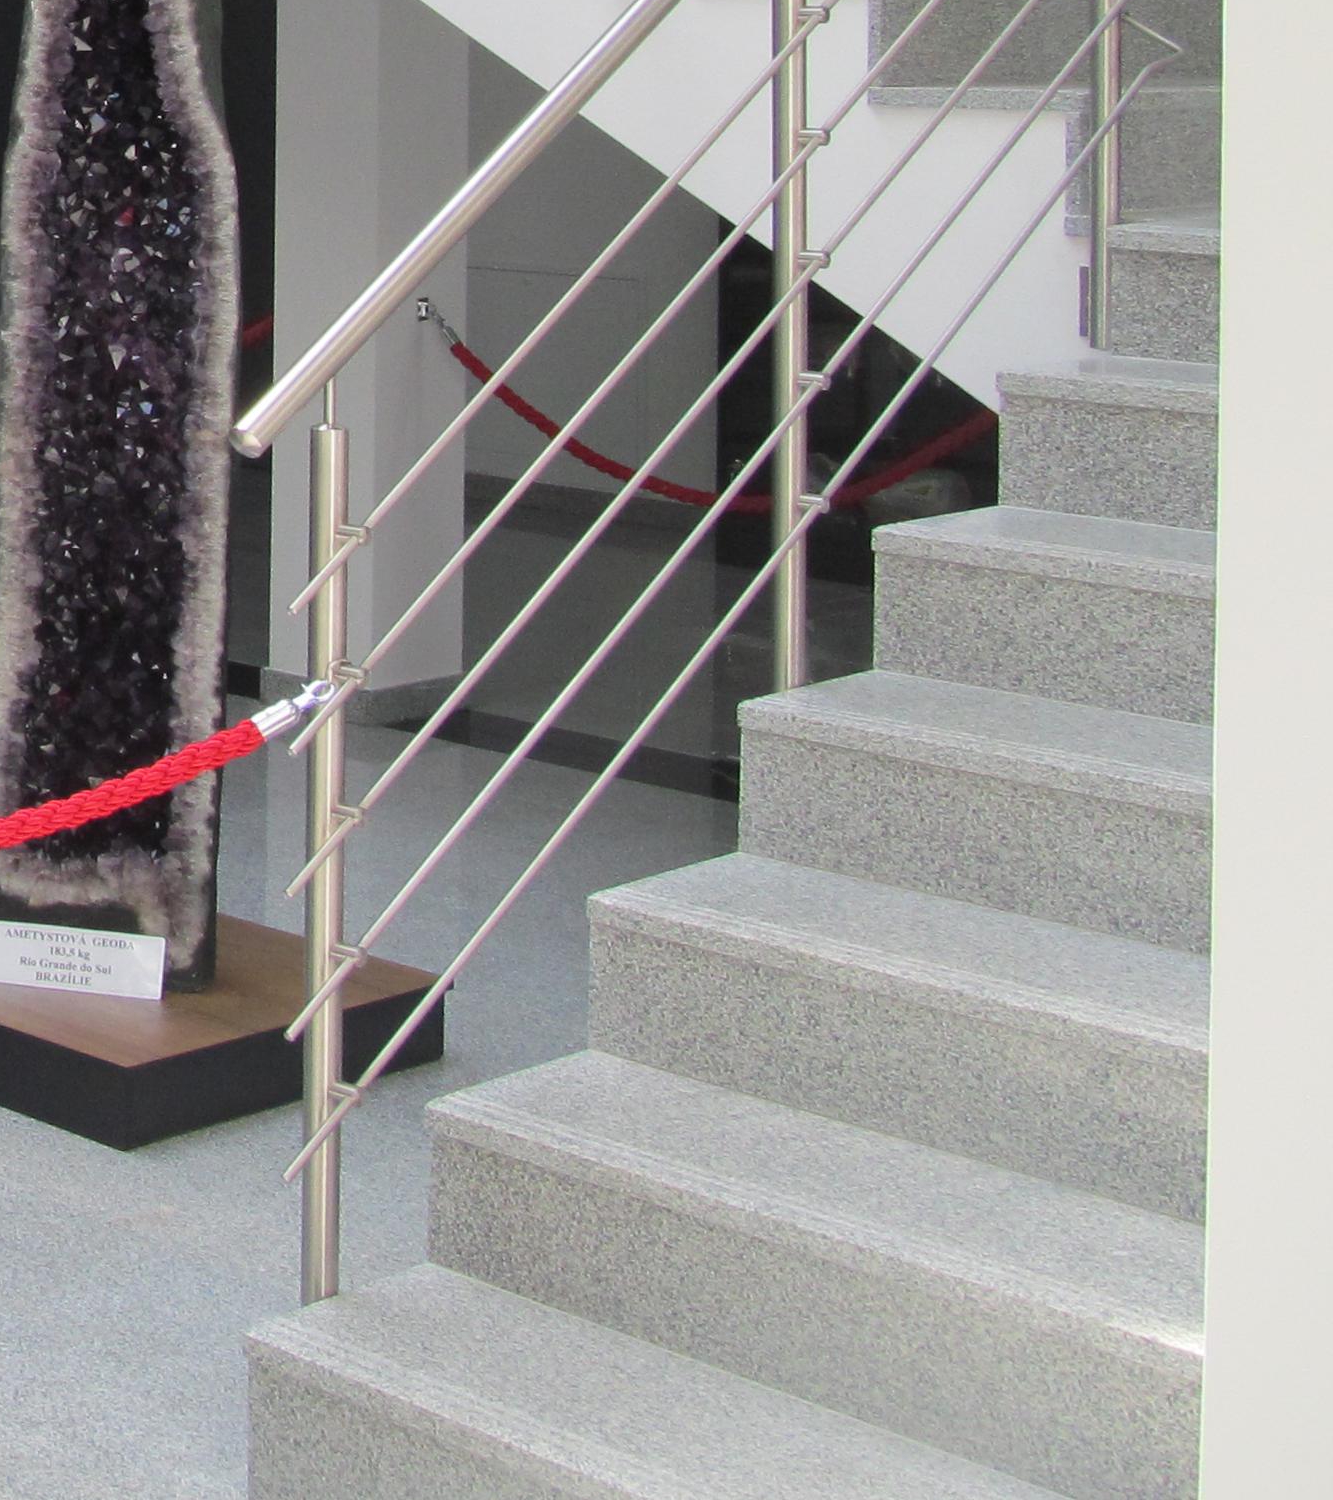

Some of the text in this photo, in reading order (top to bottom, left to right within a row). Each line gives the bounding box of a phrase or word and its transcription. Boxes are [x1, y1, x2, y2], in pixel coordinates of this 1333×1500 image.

[5, 929, 135, 950] AMETYSTOVÁ GEODA
[78, 948, 90, 960] kg
[20, 956, 111, 975] Rio Grande do Sul
[35, 972, 92, 986] BRAZÍLIE
